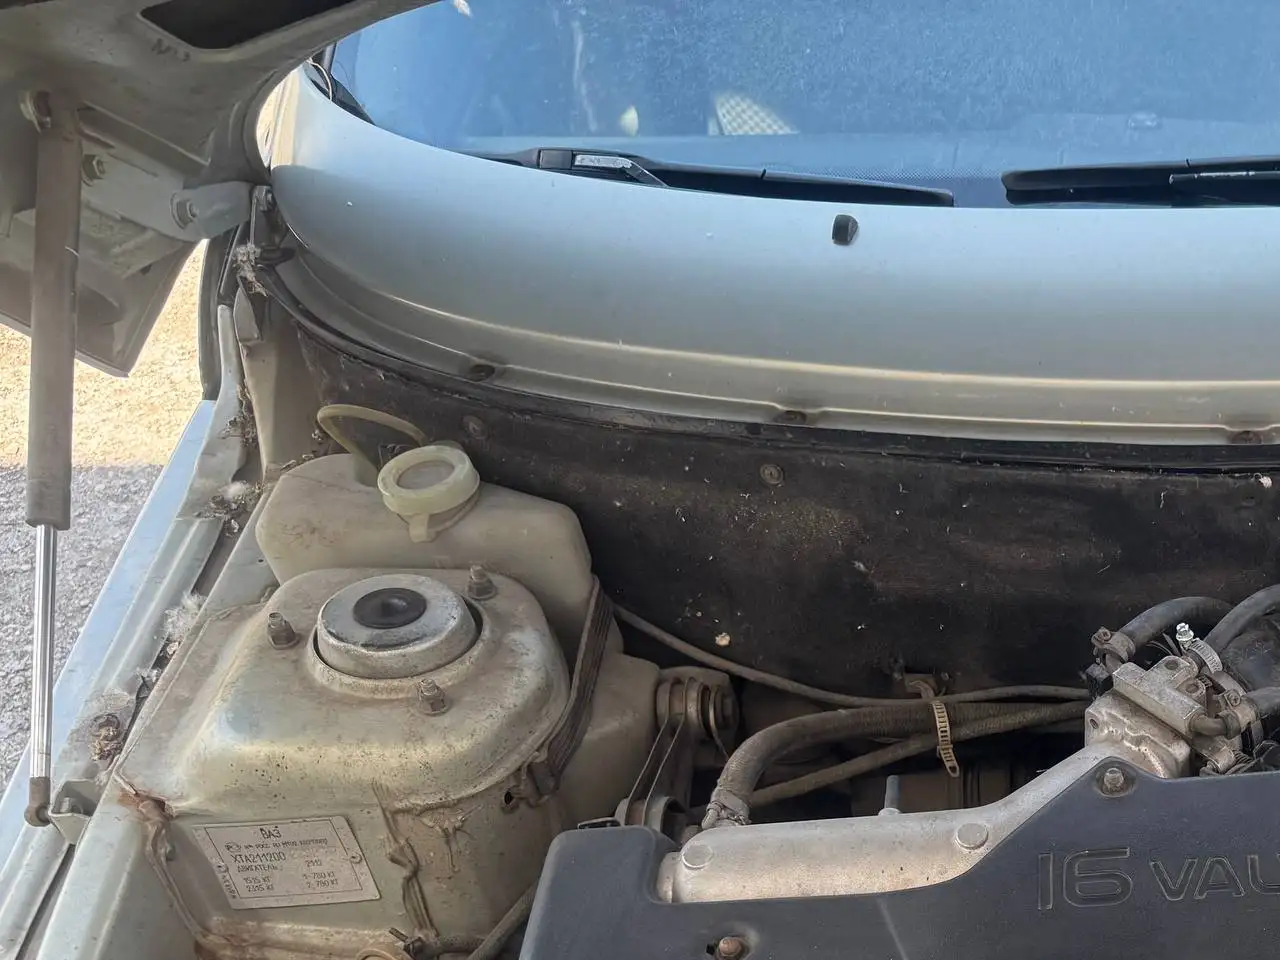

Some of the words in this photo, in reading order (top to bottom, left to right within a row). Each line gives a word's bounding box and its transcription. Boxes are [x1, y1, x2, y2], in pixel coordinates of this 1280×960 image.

[260, 827, 281, 839] ВАЗ
[231, 851, 287, 864] XTA211200
[1038, 847, 1133, 910] 16
